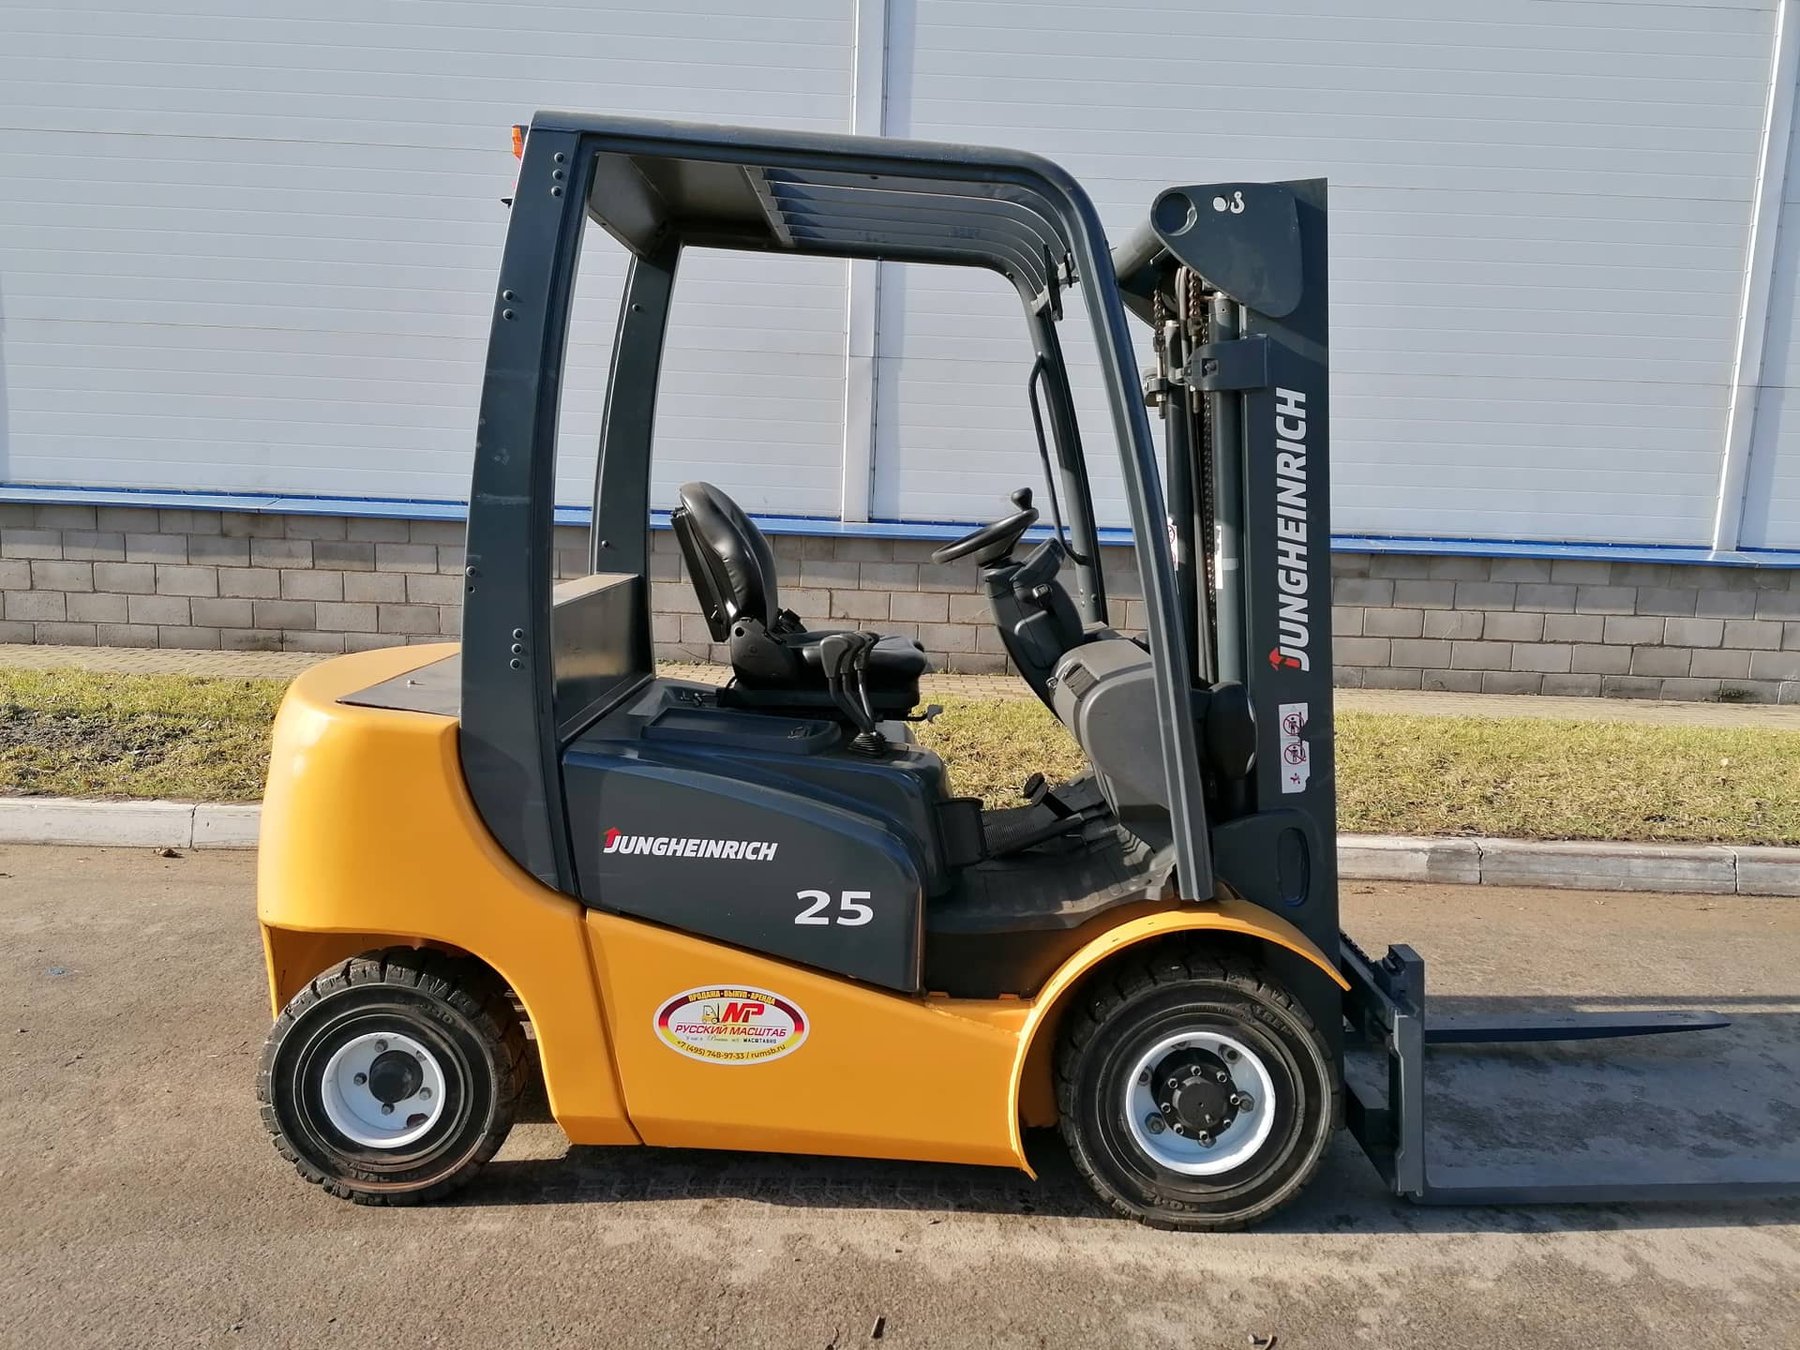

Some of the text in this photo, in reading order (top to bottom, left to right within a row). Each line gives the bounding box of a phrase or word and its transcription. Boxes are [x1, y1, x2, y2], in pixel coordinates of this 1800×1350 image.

[1276, 387, 1310, 671] JUNGHEINRICH
[603, 834, 779, 861] JUNGHEINRICH
[794, 889, 874, 926] 25
[675, 1024, 787, 1037] РУССКИЙ МАСШТАБ
[677, 1040, 686, 1049] +7
[686, 1044, 706, 1056] (495)
[706, 1050, 745, 1060] 748-97-33
[751, 1044, 786, 1059] rumsb.ru
